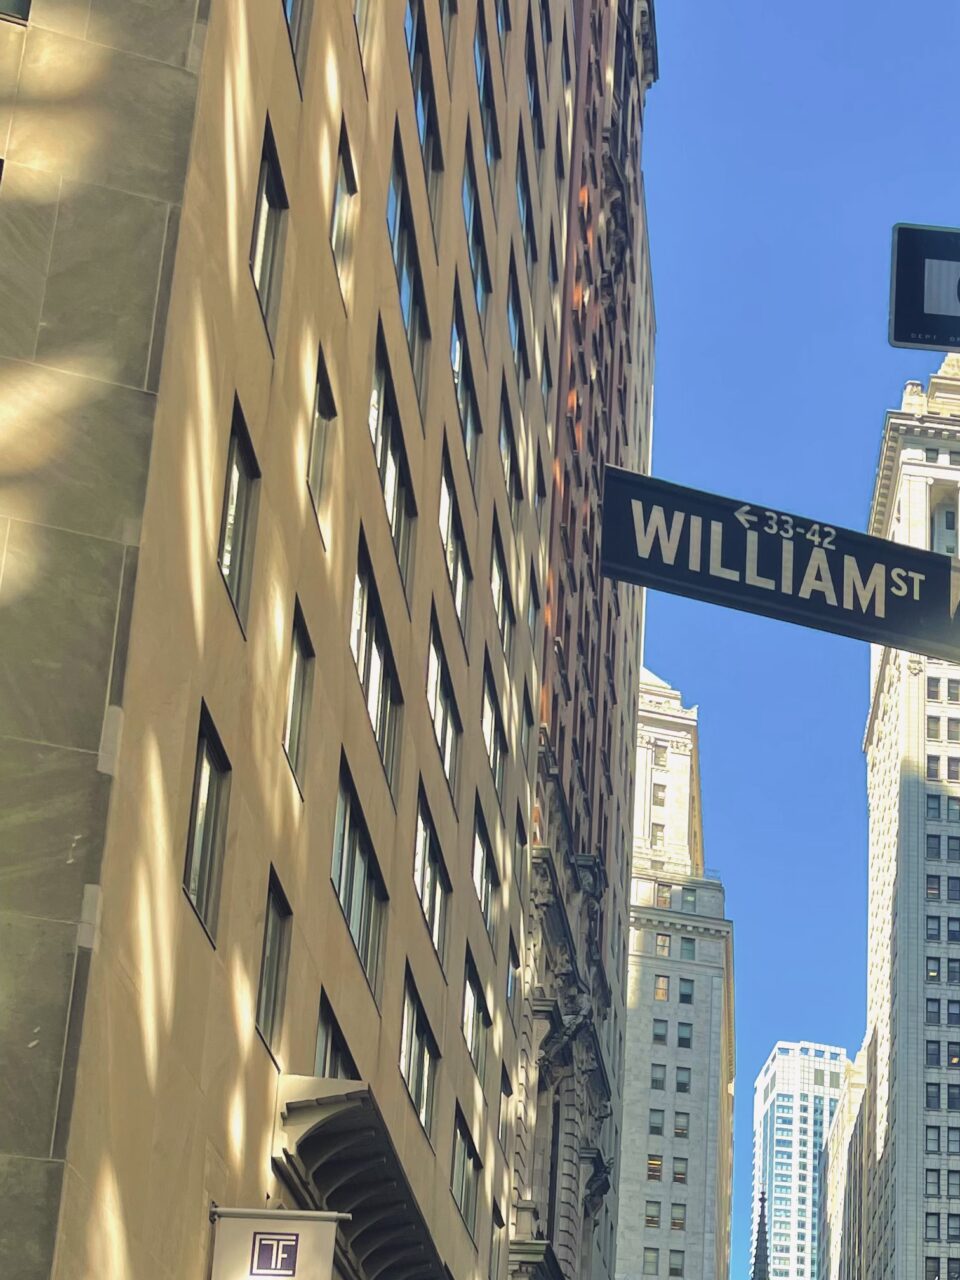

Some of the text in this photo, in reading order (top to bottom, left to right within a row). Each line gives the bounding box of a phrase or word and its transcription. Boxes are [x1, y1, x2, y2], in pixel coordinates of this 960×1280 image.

[630, 498, 926, 619] WILLIAM ST
[763, 511, 837, 551] 33-42
